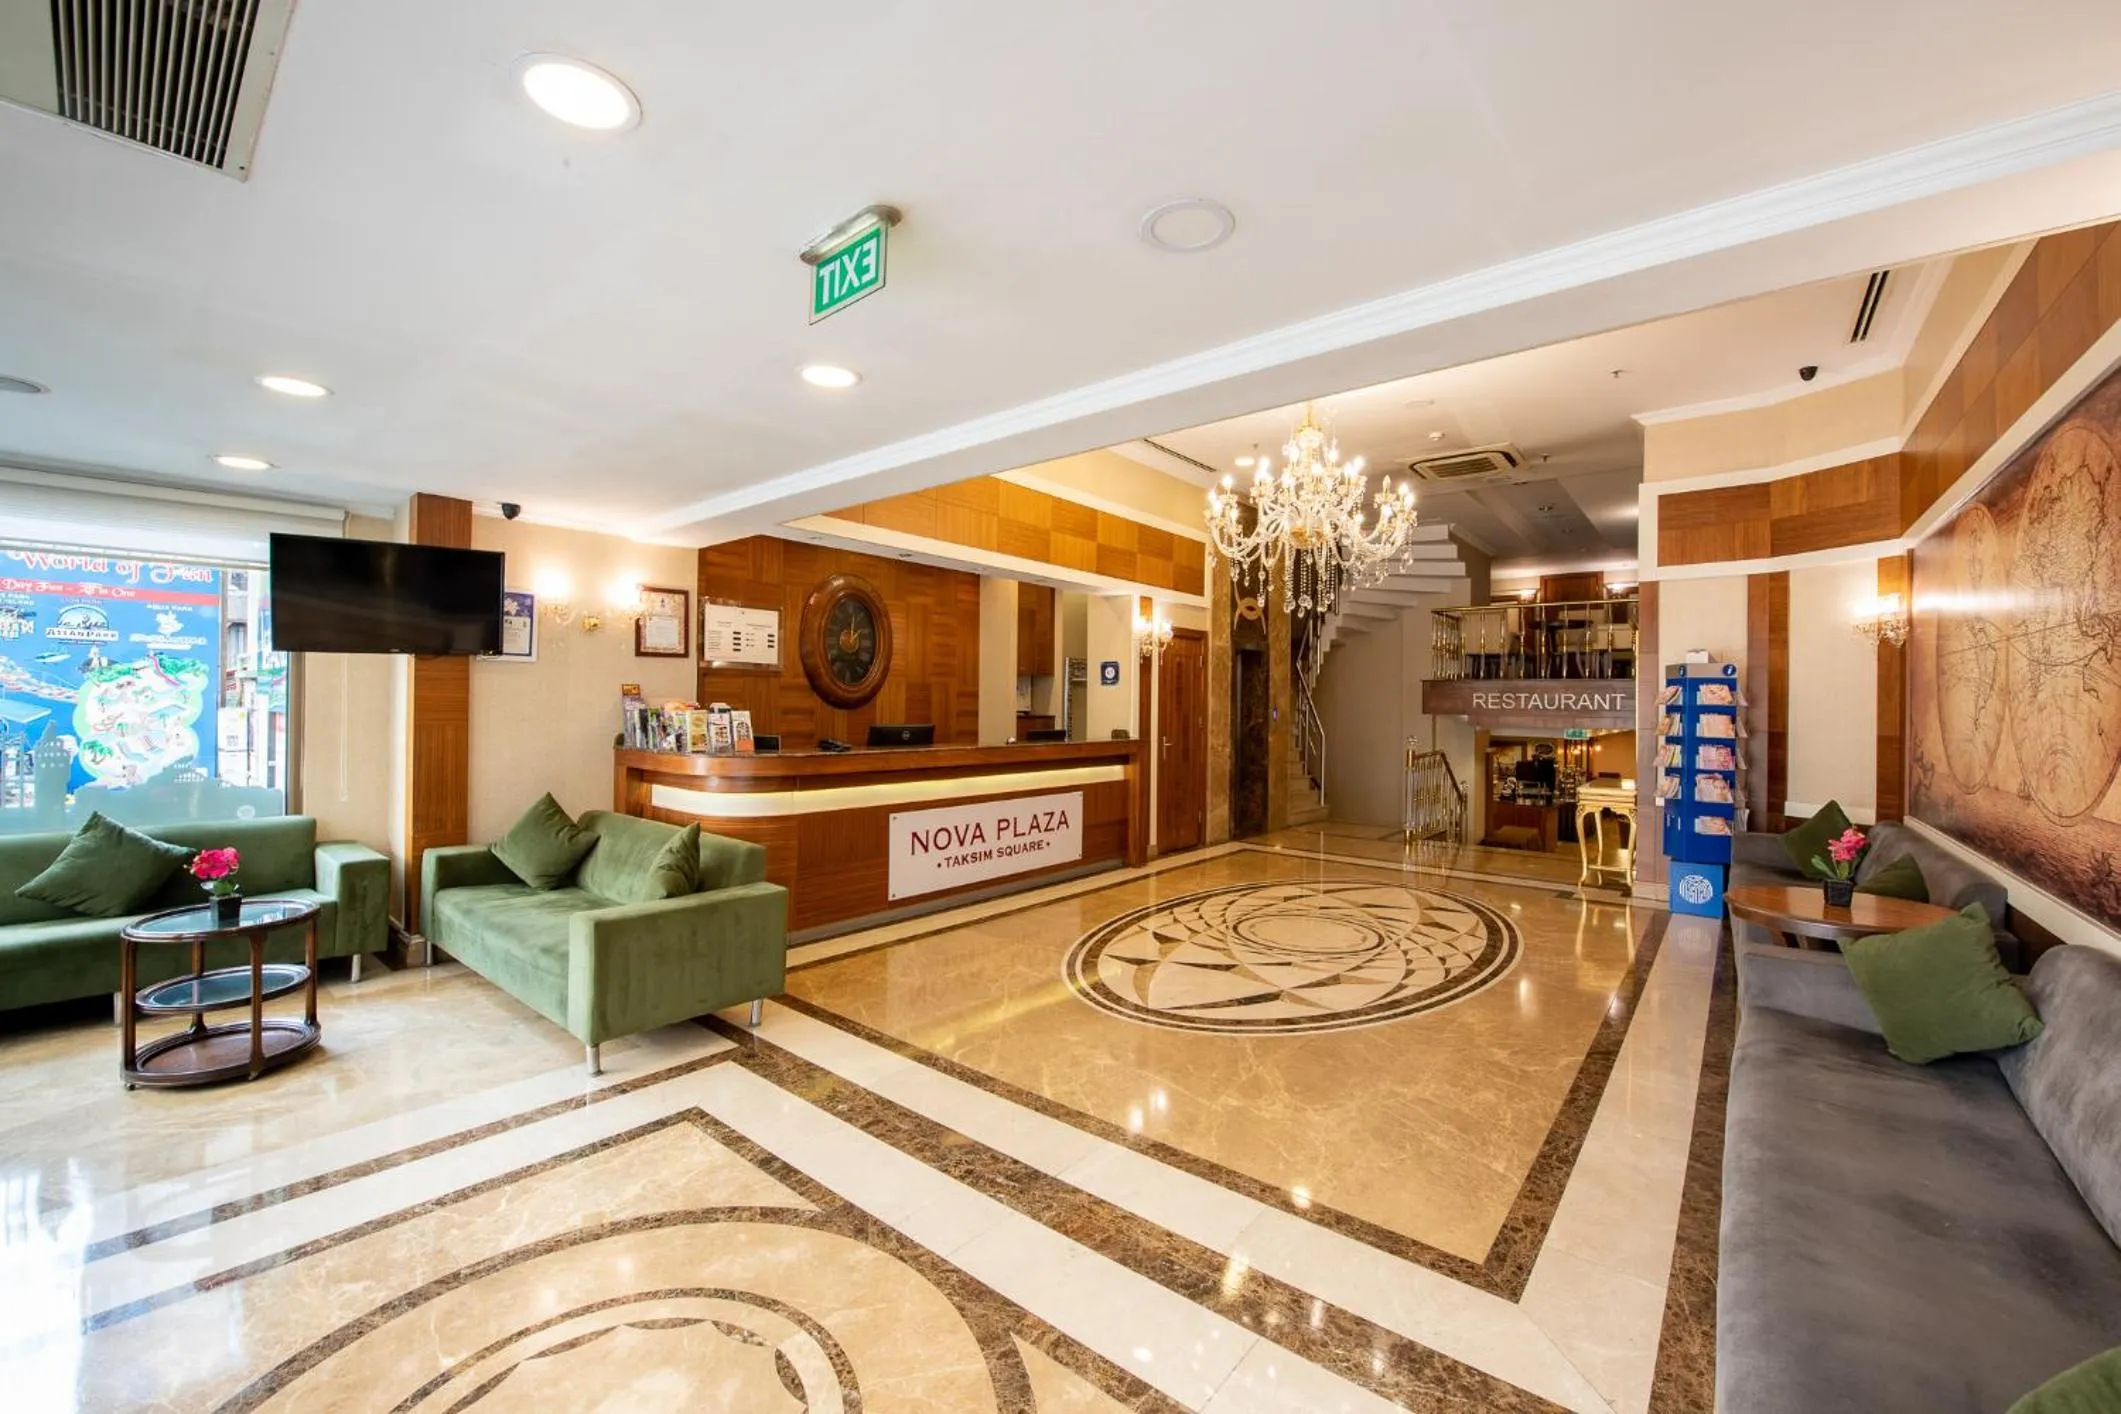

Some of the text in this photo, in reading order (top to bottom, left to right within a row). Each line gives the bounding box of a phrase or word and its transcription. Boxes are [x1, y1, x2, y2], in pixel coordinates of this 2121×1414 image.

[7, 552, 214, 584] World of Fun
[1472, 691, 1627, 711] RESTAURANT
[910, 809, 1070, 856] NOVA PLAZA
[944, 839, 1045, 869] TAKSIM SQUARE
